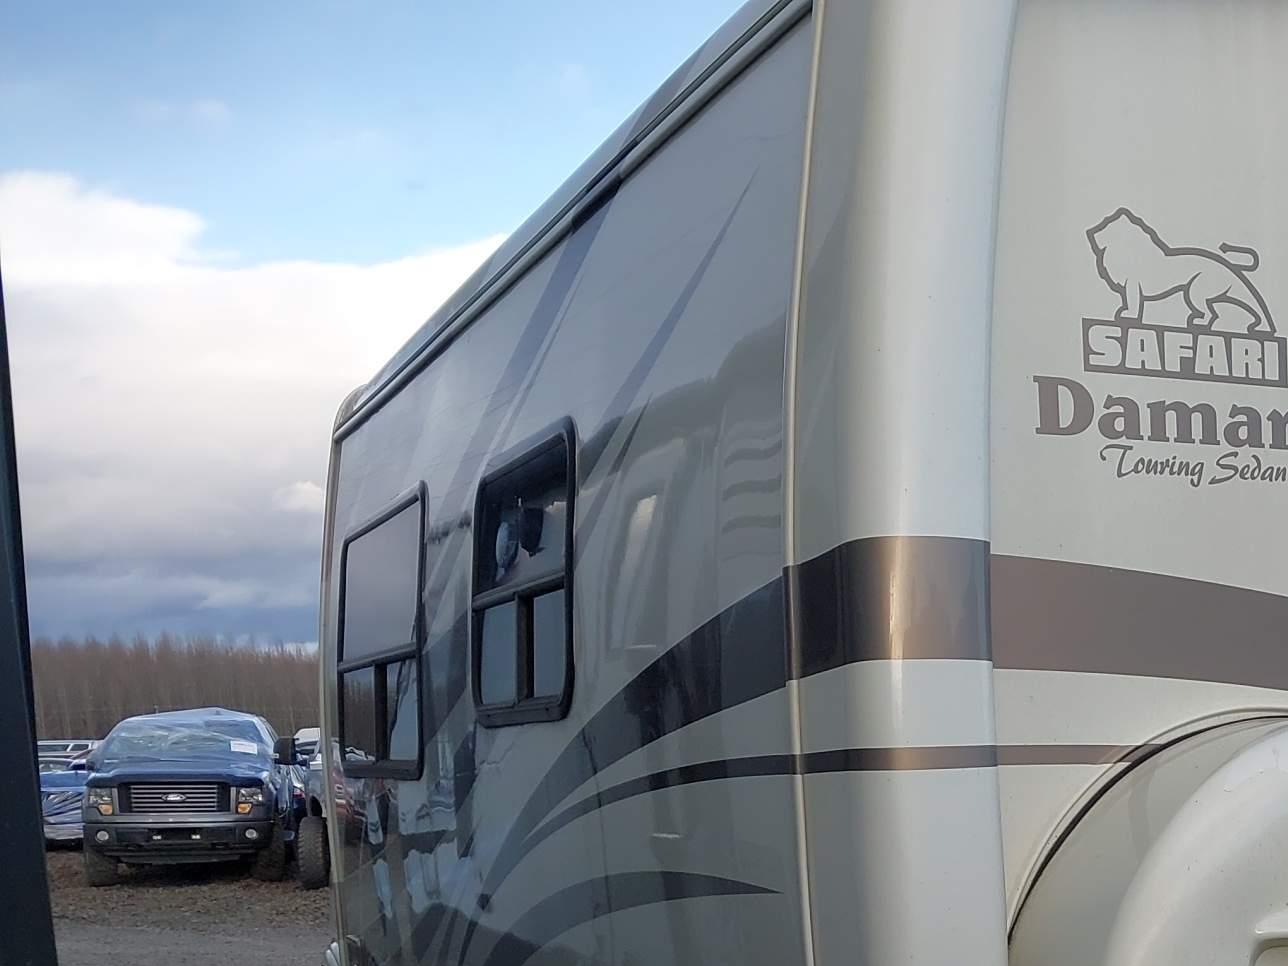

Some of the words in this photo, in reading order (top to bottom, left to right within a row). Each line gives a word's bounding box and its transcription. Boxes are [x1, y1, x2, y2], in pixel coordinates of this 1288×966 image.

[1086, 324, 1280, 382] SAFARI
[1099, 443, 1205, 488] Touring
[1208, 451, 1288, 487] Sedan
